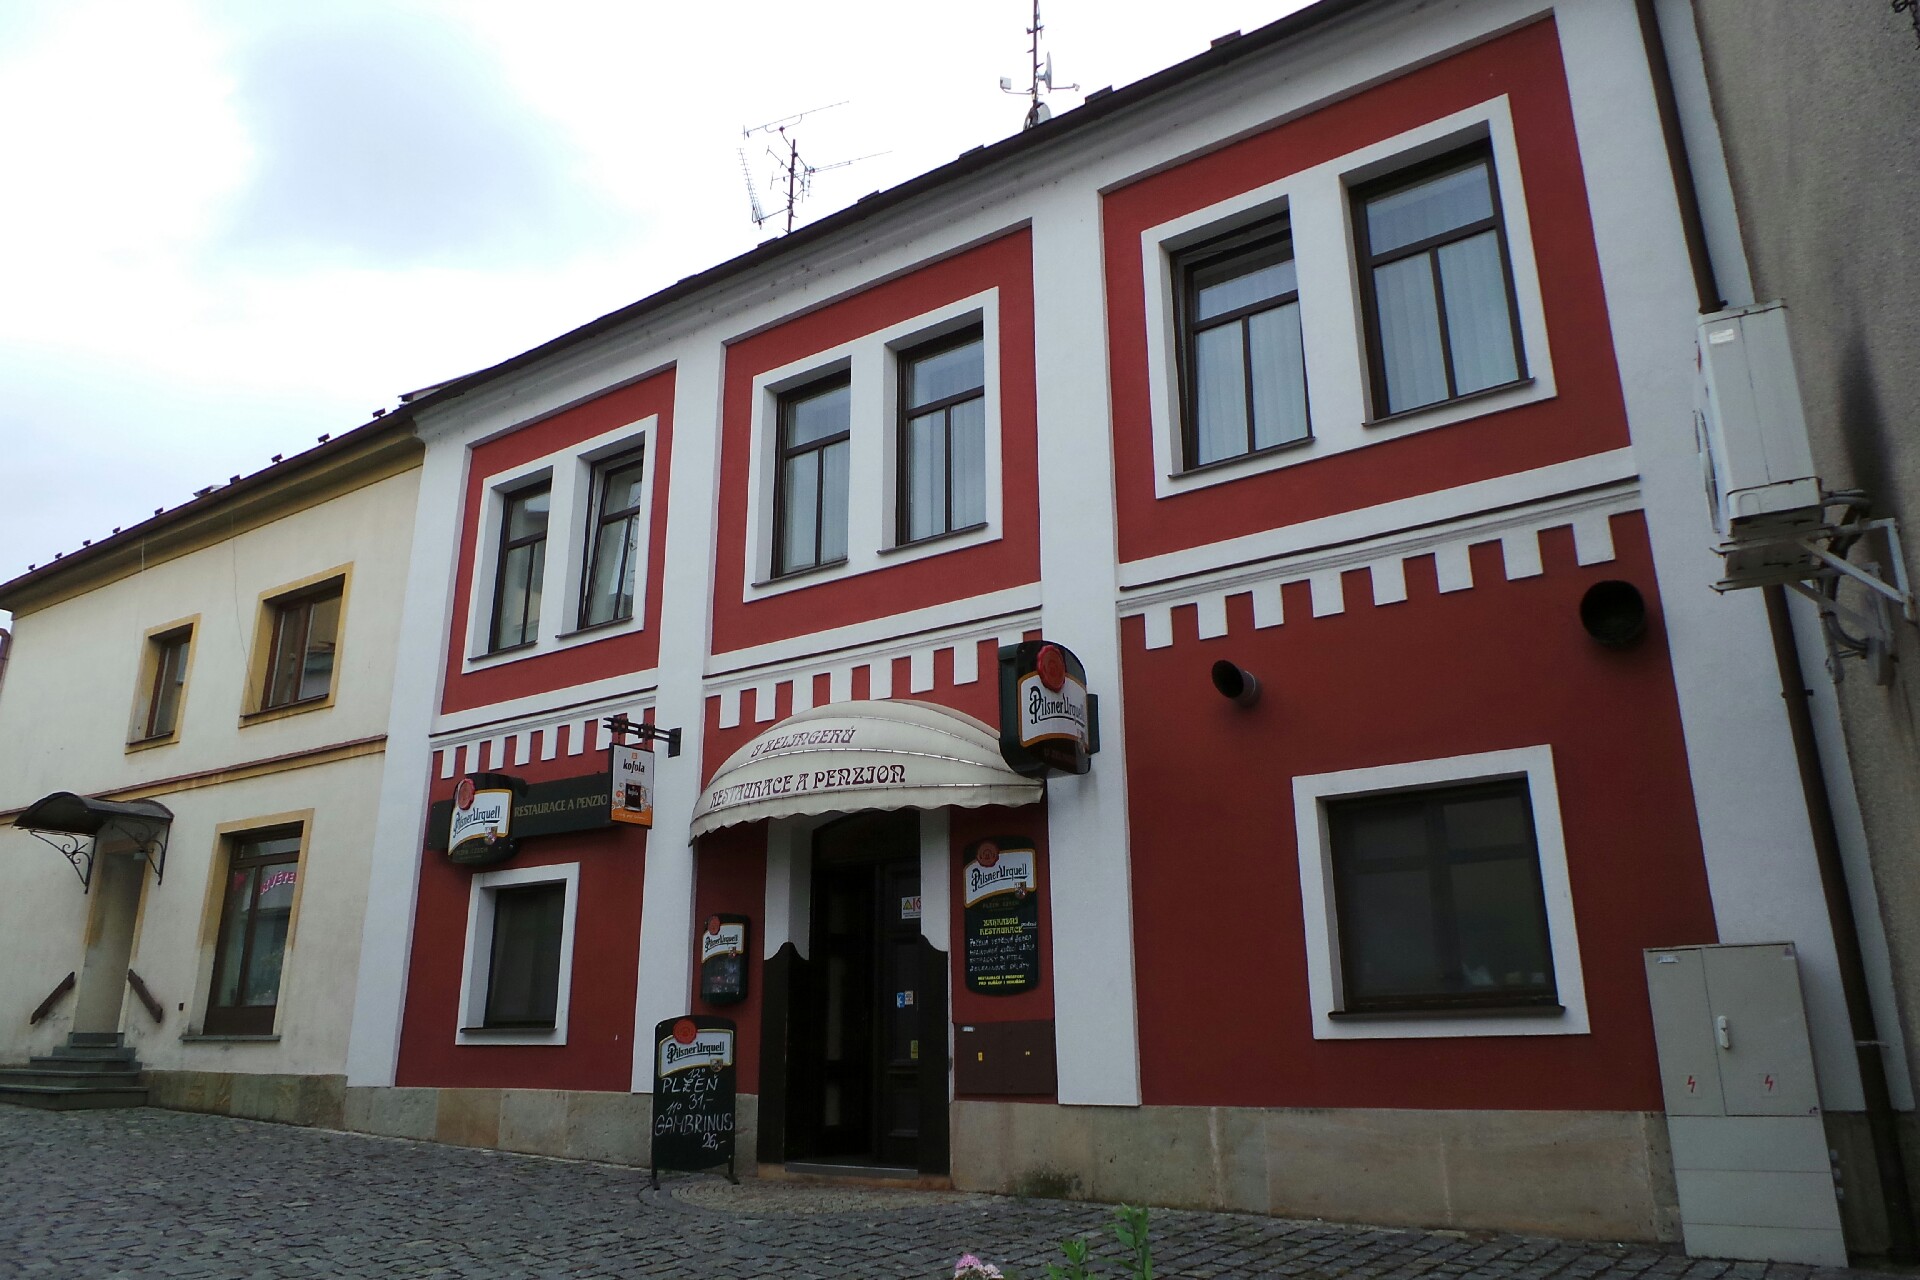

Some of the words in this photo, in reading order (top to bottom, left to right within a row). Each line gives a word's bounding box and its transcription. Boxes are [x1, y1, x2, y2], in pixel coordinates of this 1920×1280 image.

[1029, 686, 1062, 724] Pilsner
[710, 774, 793, 808] RESTAURACE
[796, 774, 809, 791] A
[813, 764, 906, 788] PENZION
[514, 800, 566, 817] RESTAURACE
[568, 799, 574, 810] A
[576, 794, 608, 808] PENZIO
[453, 811, 473, 838] Pilsner
[473, 805, 500, 825] Urquell
[972, 868, 1000, 892] Pilsner
[999, 864, 1027, 880] Urquell
[667, 1042, 696, 1064] Pilsner
[696, 1041, 724, 1056] Urquell
[654, 1112, 734, 1136] GAMBRINUS
